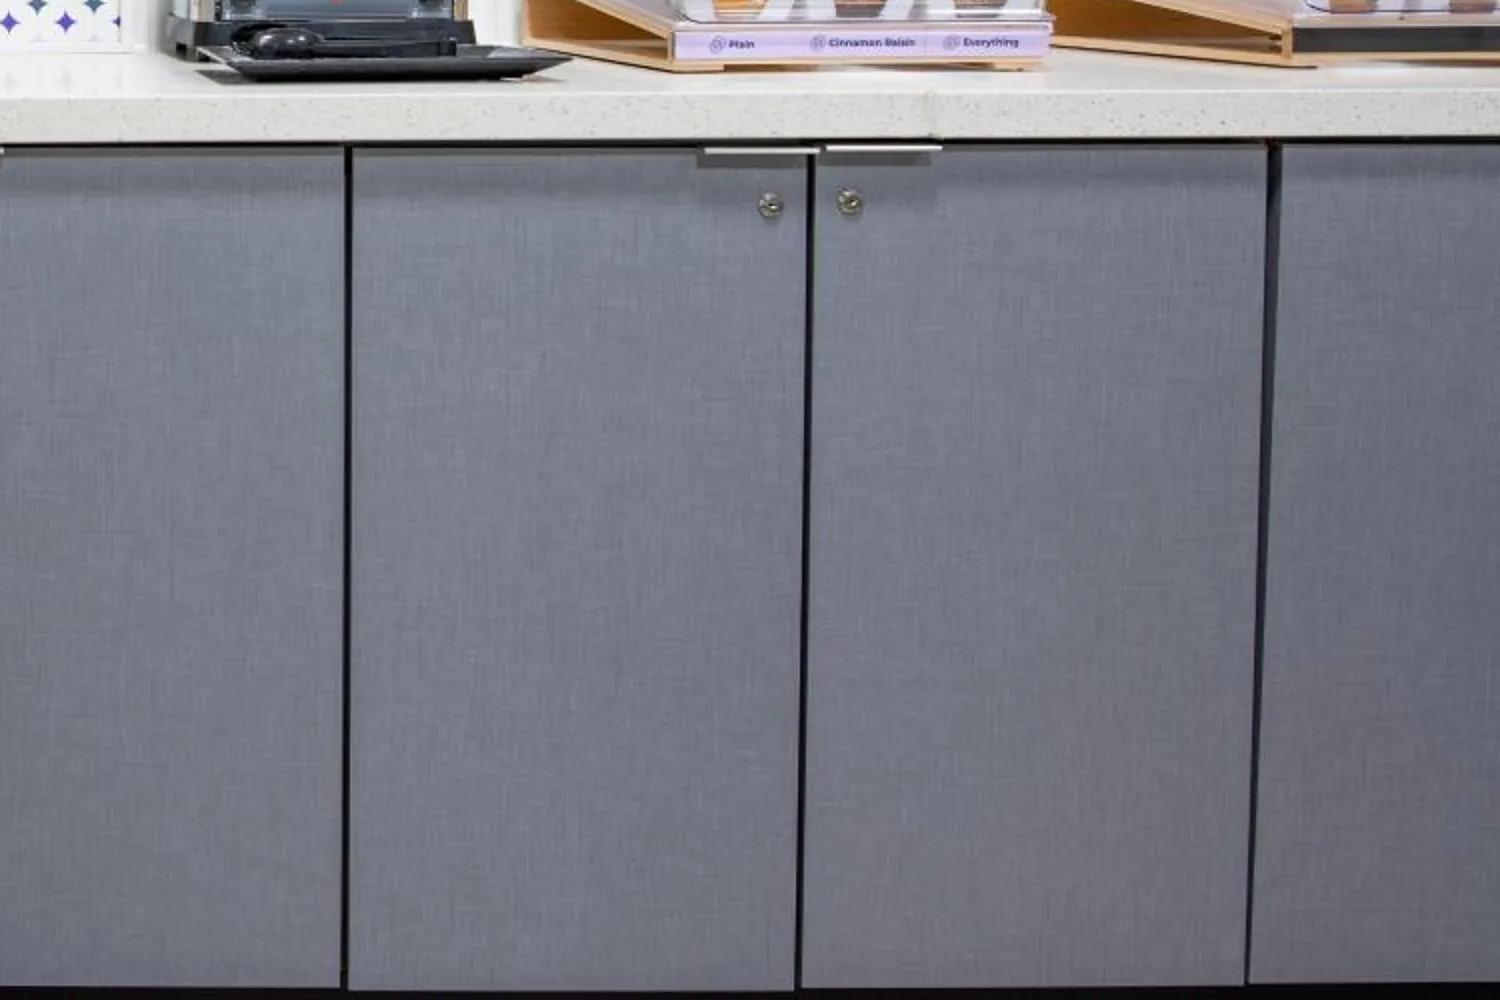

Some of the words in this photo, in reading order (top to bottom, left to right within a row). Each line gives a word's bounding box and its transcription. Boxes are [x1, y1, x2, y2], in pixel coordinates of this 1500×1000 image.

[728, 39, 756, 49] Plain
[829, 38, 882, 48] Cinnamon
[963, 37, 1019, 49] Everything
